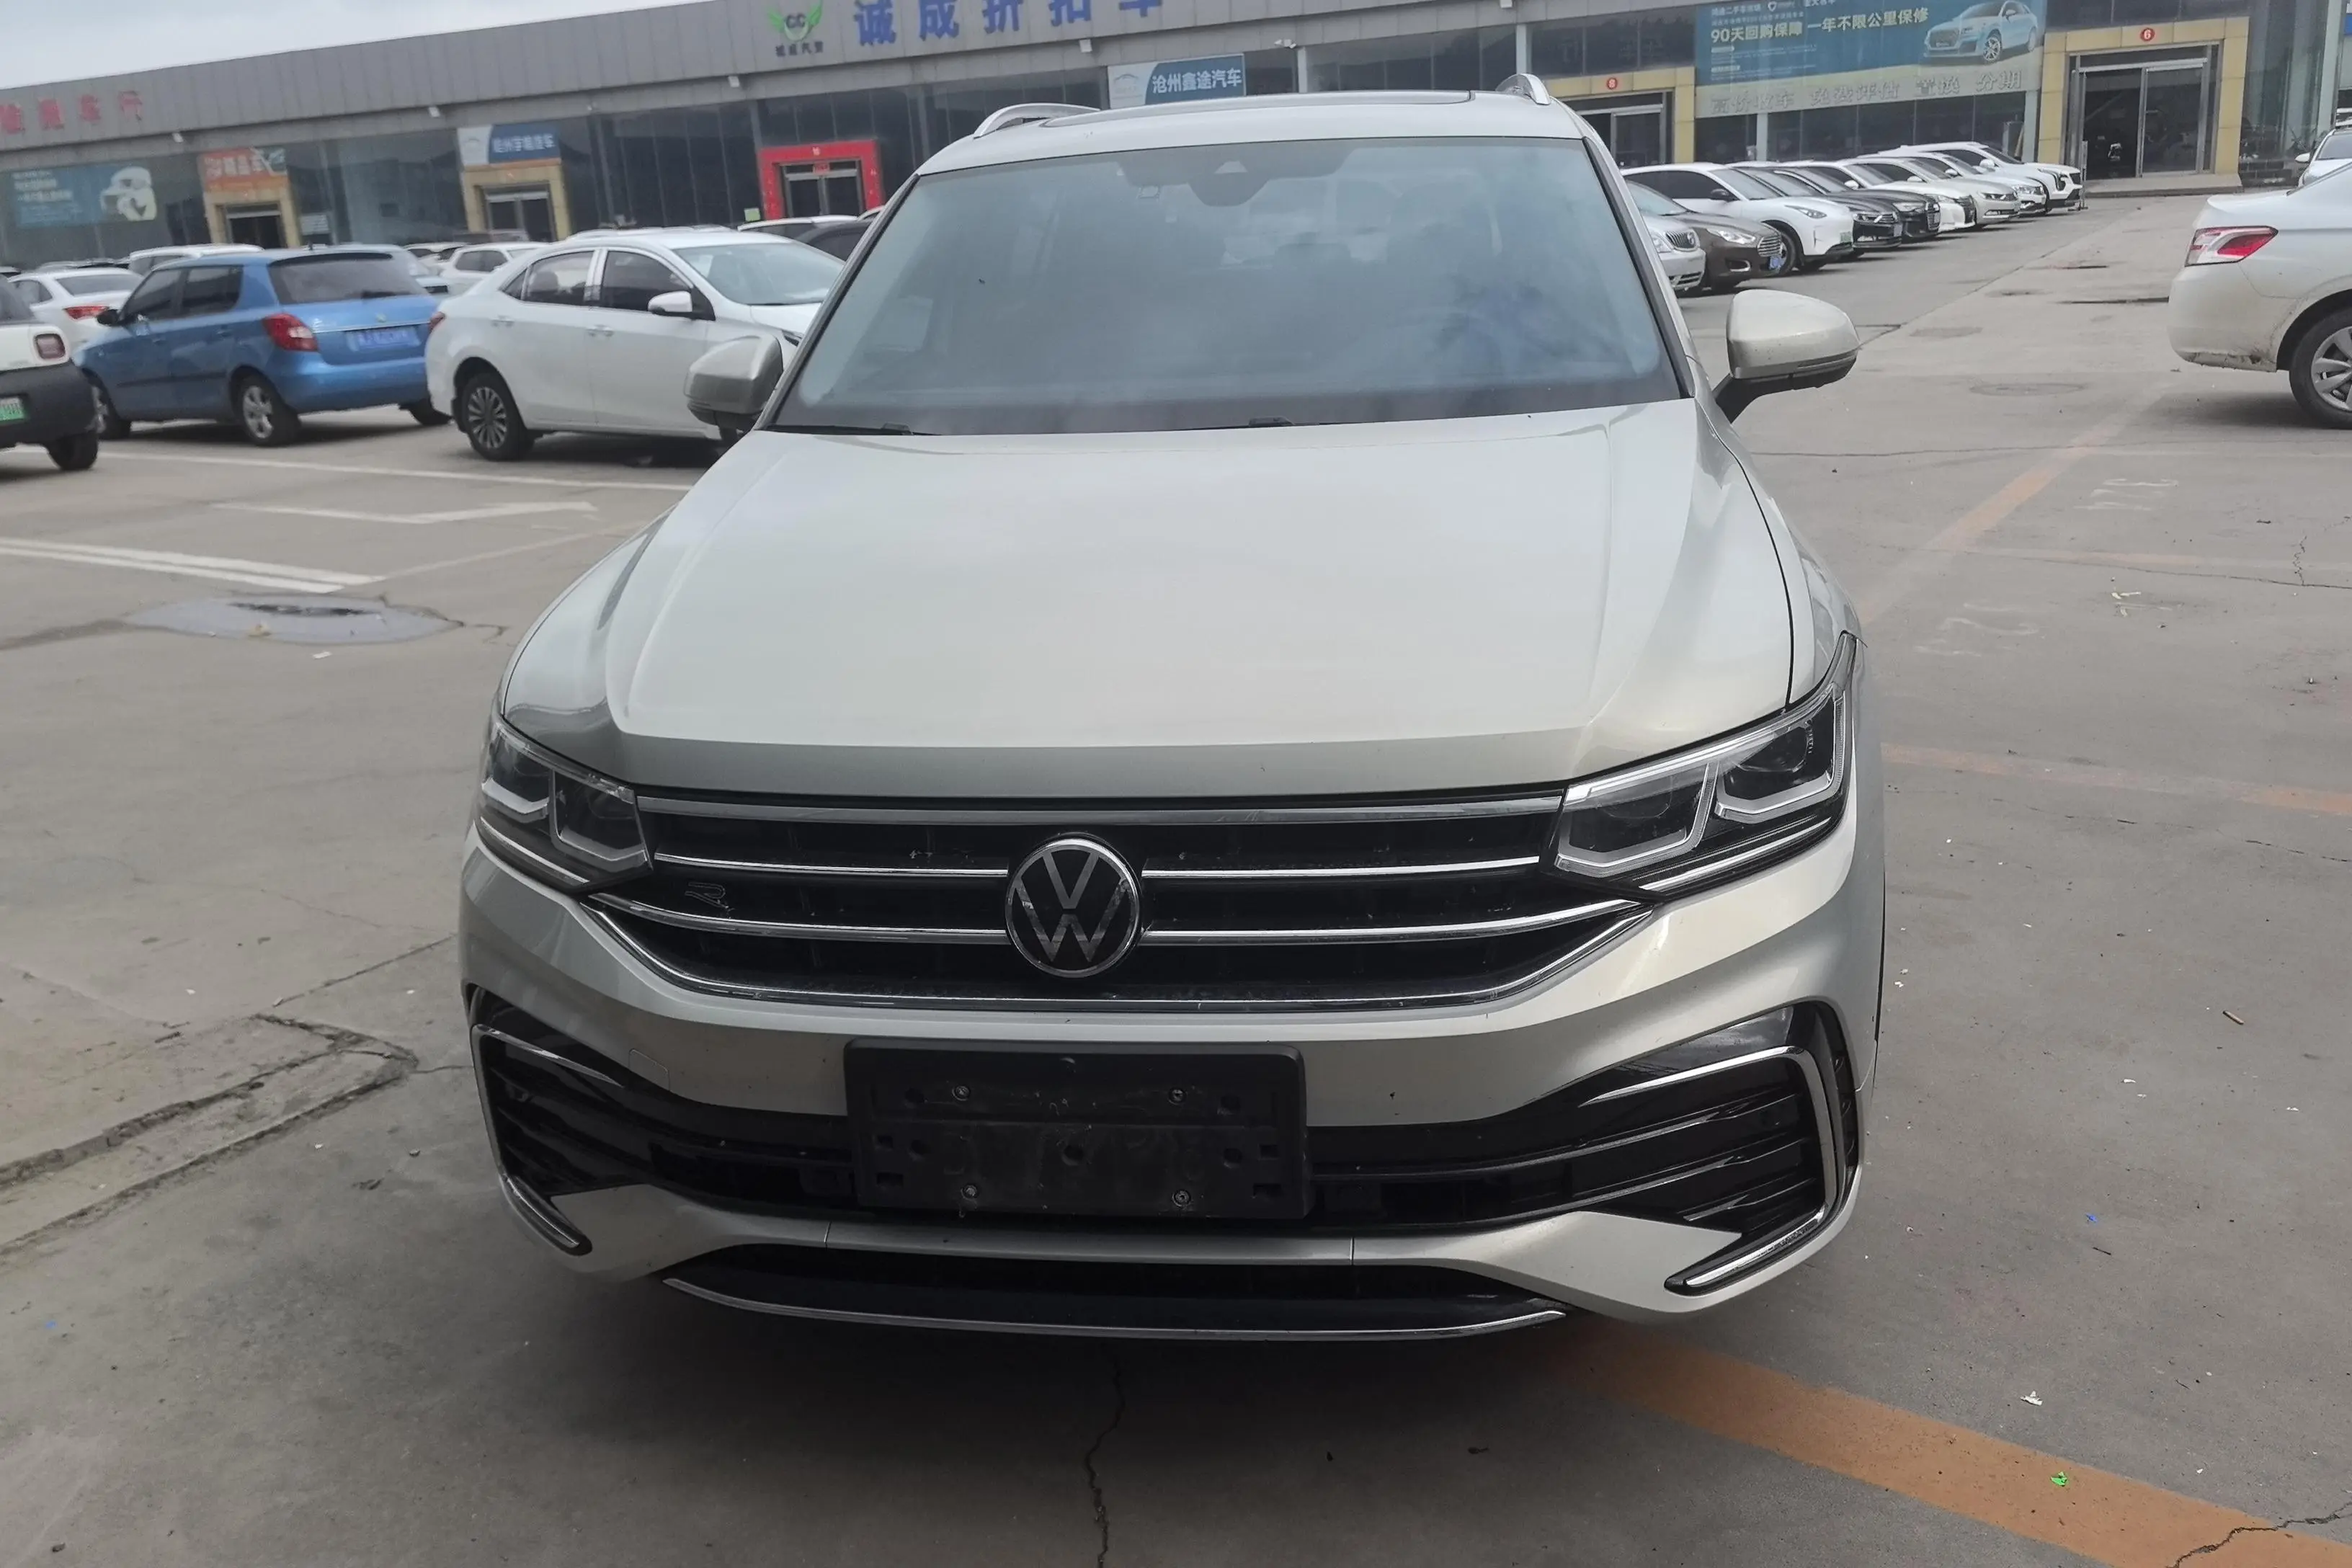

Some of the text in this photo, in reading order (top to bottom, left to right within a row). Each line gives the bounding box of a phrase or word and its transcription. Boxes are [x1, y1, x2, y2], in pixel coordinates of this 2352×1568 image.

[1807, 7, 1928, 32] 一年不限公里保修
[1152, 68, 1242, 94] 沧州鑫途汽车
[1809, 80, 1900, 107] 免费评估
[1976, 69, 2022, 92] 分期
